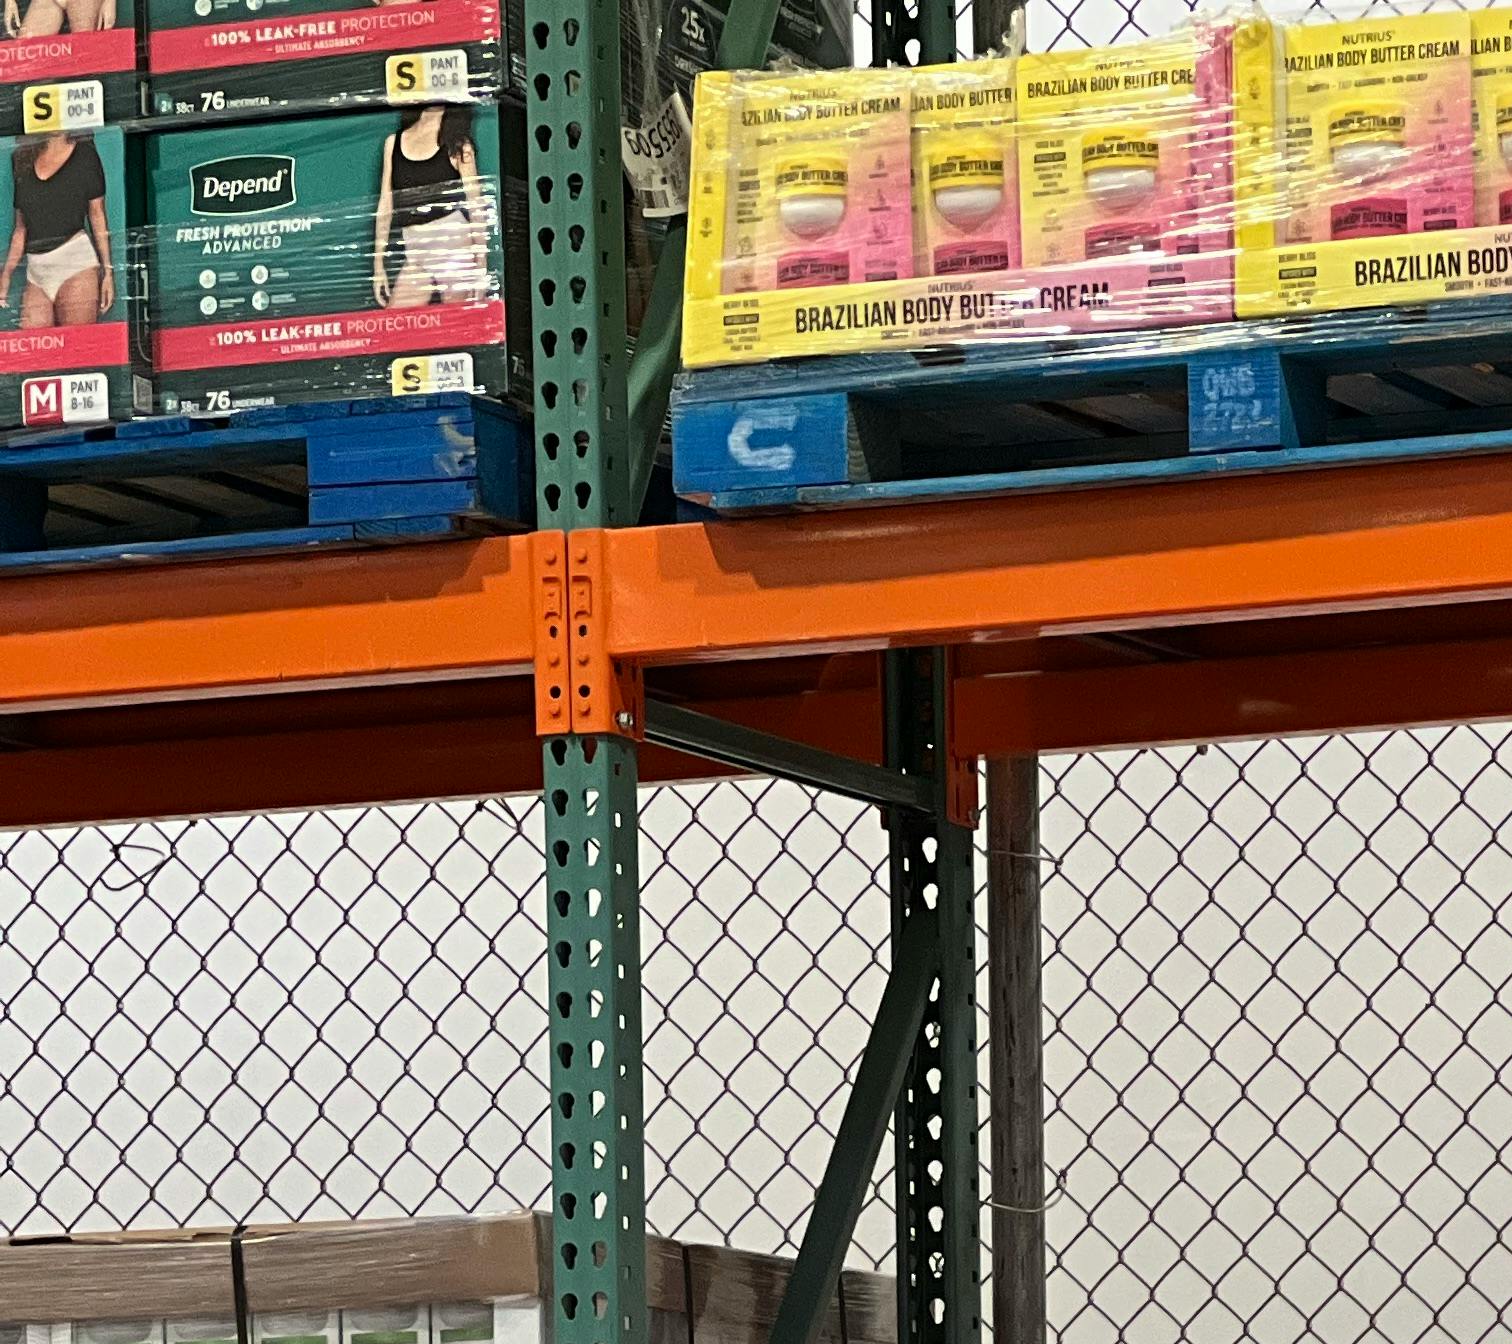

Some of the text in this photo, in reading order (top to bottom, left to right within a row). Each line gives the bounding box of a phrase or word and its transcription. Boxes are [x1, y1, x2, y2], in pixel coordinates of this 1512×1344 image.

[396, 57, 459, 90] S PANT
[33, 87, 95, 120] S PANT
[202, 170, 283, 200] Depend
[176, 225, 220, 243] FRESH
[202, 235, 282, 254] ADVANCED
[1355, 246, 1462, 286] BRAZILIAN
[216, 312, 441, 346] 100% LEAK-FREE PROTECTION
[796, 298, 896, 334] BRAZILIAN
[902, 294, 951, 324] BODY
[29, 379, 99, 415] M PANT
[206, 390, 231, 411] 76
